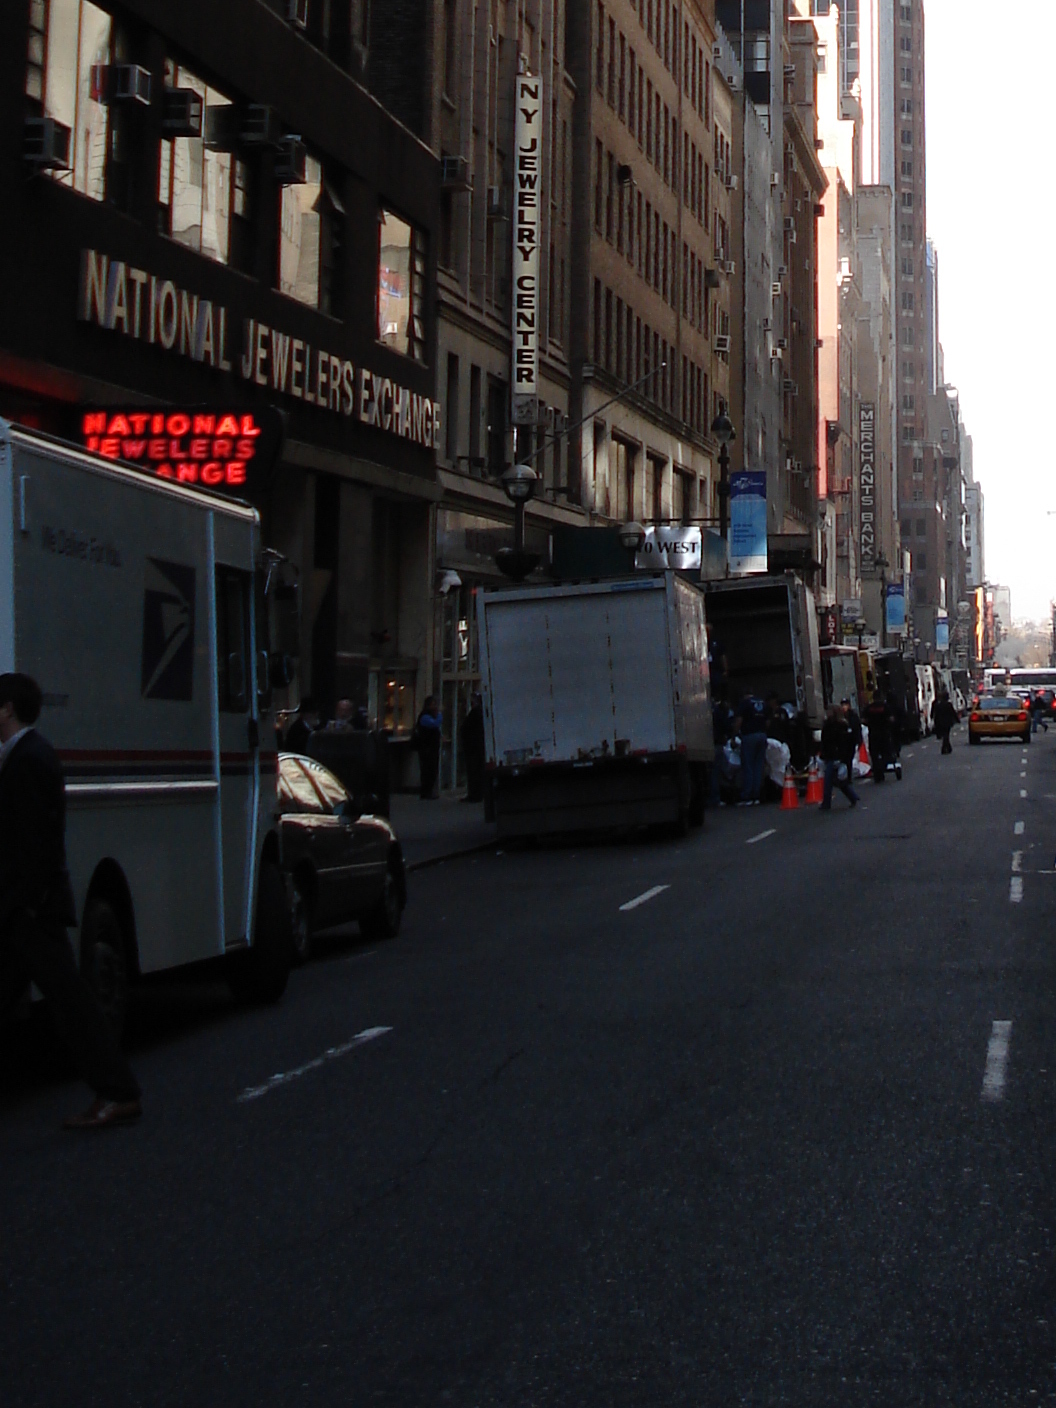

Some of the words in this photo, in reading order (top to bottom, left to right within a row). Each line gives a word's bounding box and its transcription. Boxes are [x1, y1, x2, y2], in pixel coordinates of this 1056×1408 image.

[517, 138, 538, 262] JEWELRY
[79, 248, 232, 372] NATIONAL
[242, 317, 355, 416] JEWELERS
[359, 367, 442, 450] EXCHANGE
[515, 275, 535, 383] CENTER
[83, 410, 262, 437] NATIONAL
[860, 410, 874, 506] MERCHANTS
[658, 541, 698, 554] WEST
[861, 512, 874, 555] BANK
